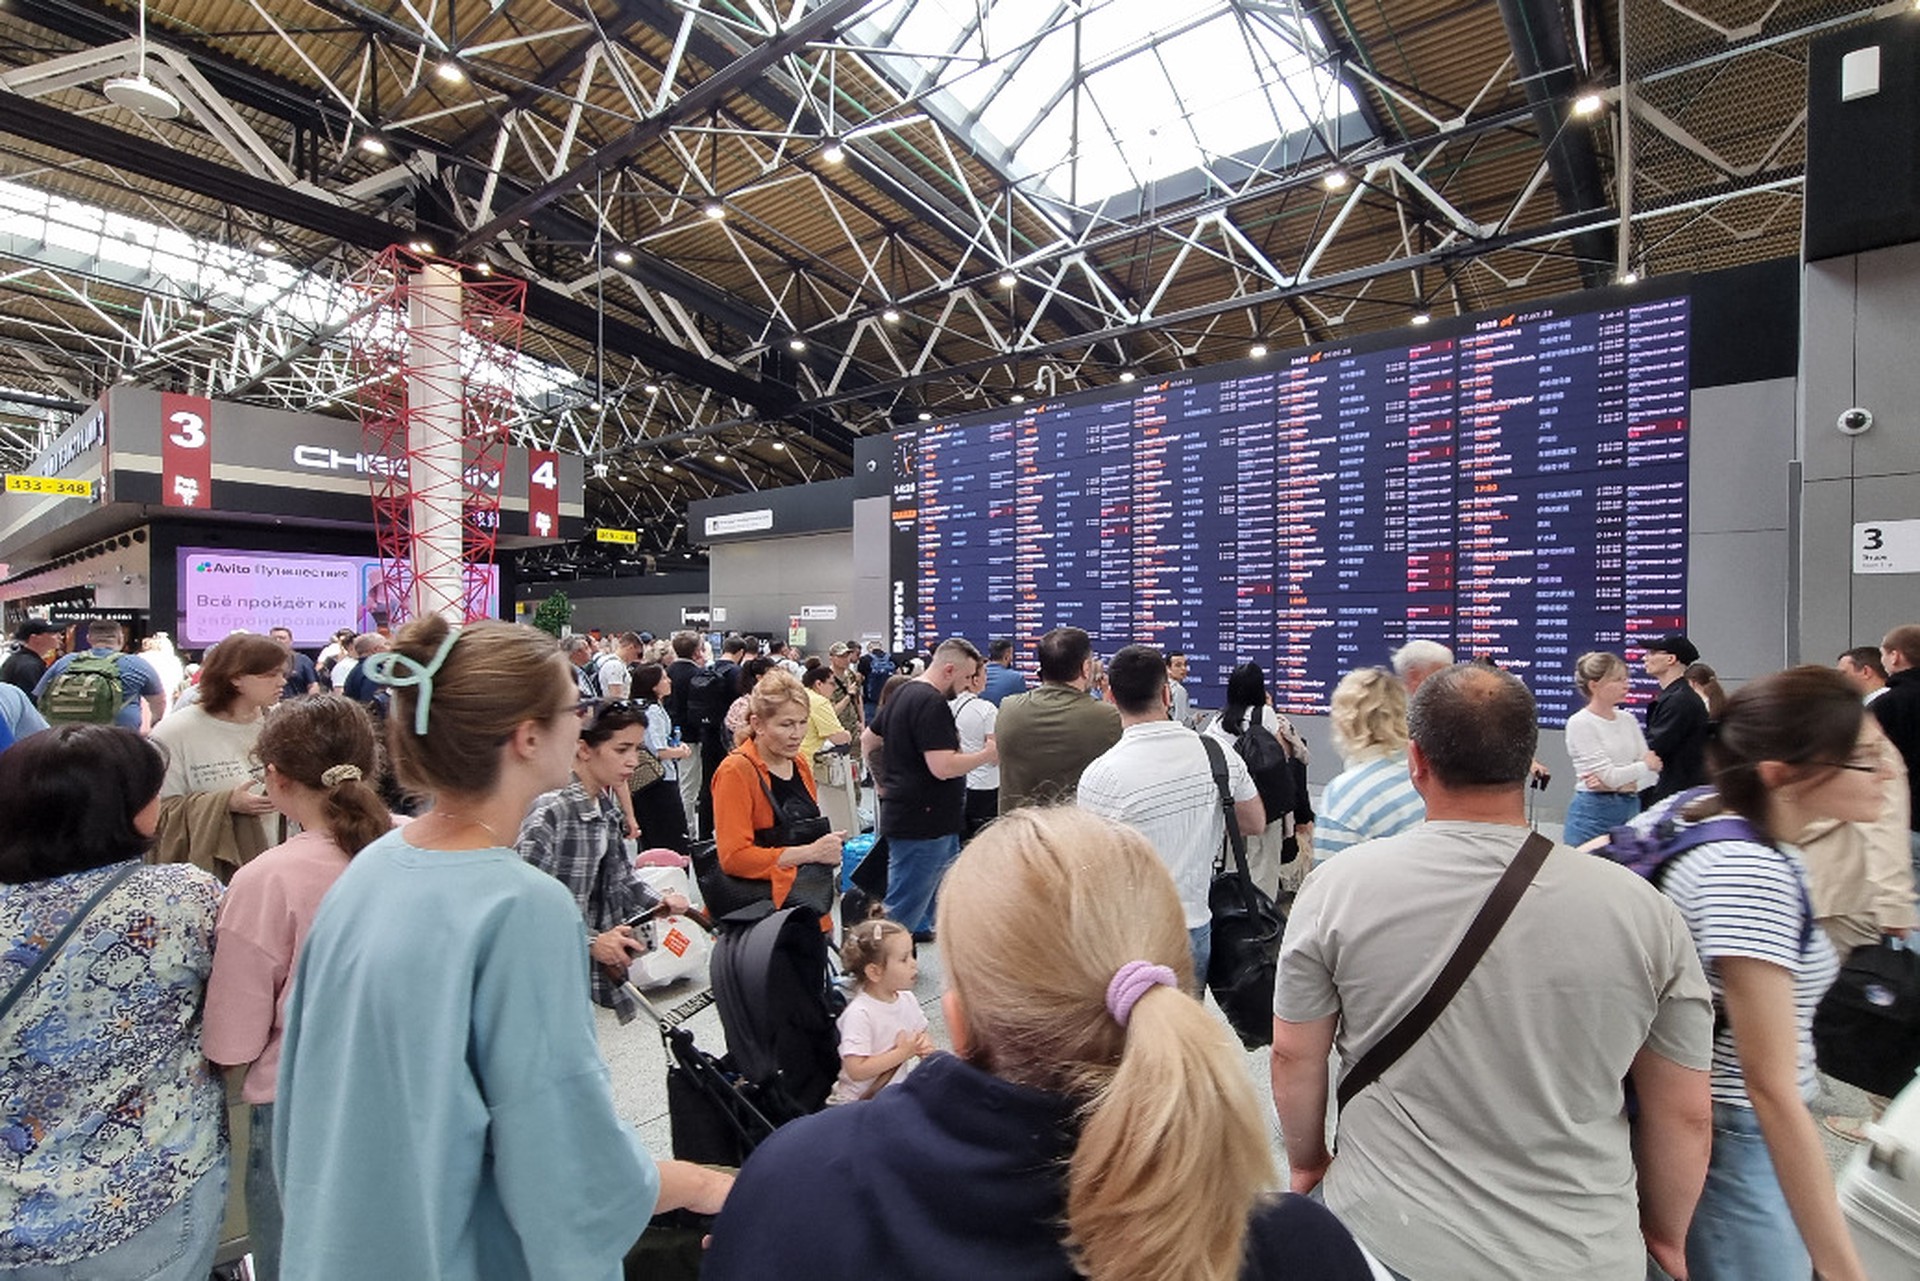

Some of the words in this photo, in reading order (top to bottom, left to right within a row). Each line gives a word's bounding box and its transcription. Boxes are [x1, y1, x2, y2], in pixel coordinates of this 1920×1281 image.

[169, 411, 206, 449] 3
[531, 461, 557, 489] 4
[11, 480, 41, 491] 333
[56, 482, 86, 494] 348
[1863, 528, 1884, 550] 3
[213, 562, 251, 575] Avito
[197, 594, 232, 608] Всё
[237, 596, 315, 611] пройдёт
[319, 600, 347, 610] как
